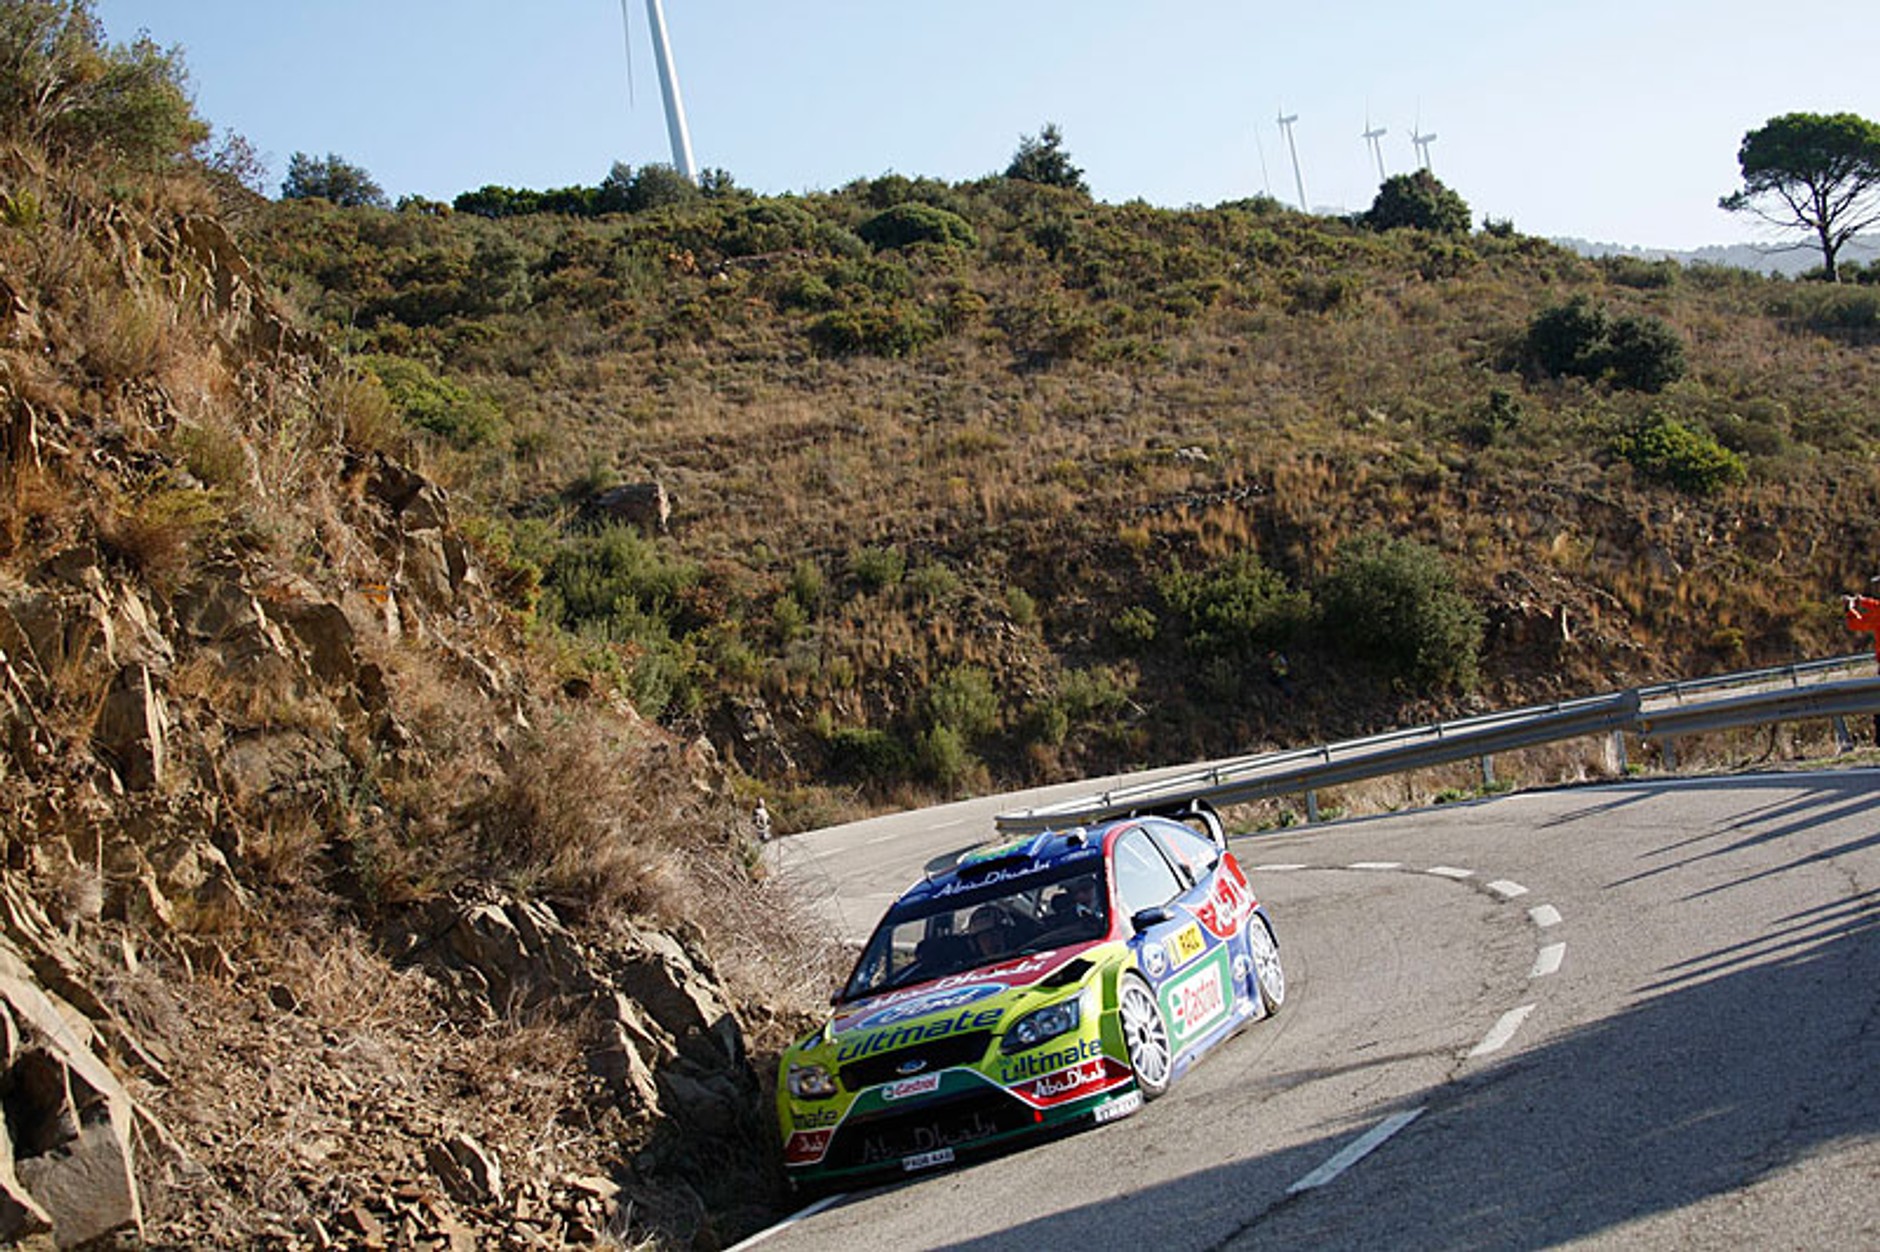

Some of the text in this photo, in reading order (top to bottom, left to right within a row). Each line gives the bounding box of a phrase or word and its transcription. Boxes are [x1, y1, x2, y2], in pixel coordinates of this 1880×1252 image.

[933, 860, 1052, 899] Abu Dhabi
[934, 959, 1047, 990] Dhabi
[879, 988, 981, 1023] Ford
[1183, 968, 1222, 1028] Castrol
[837, 1007, 1005, 1062] ultimate
[1002, 1038, 1102, 1083] ultimate
[1031, 1060, 1106, 1099] Abu Dhab
[895, 1075, 937, 1096] Castrol
[913, 1112, 1000, 1152] Dhabi
